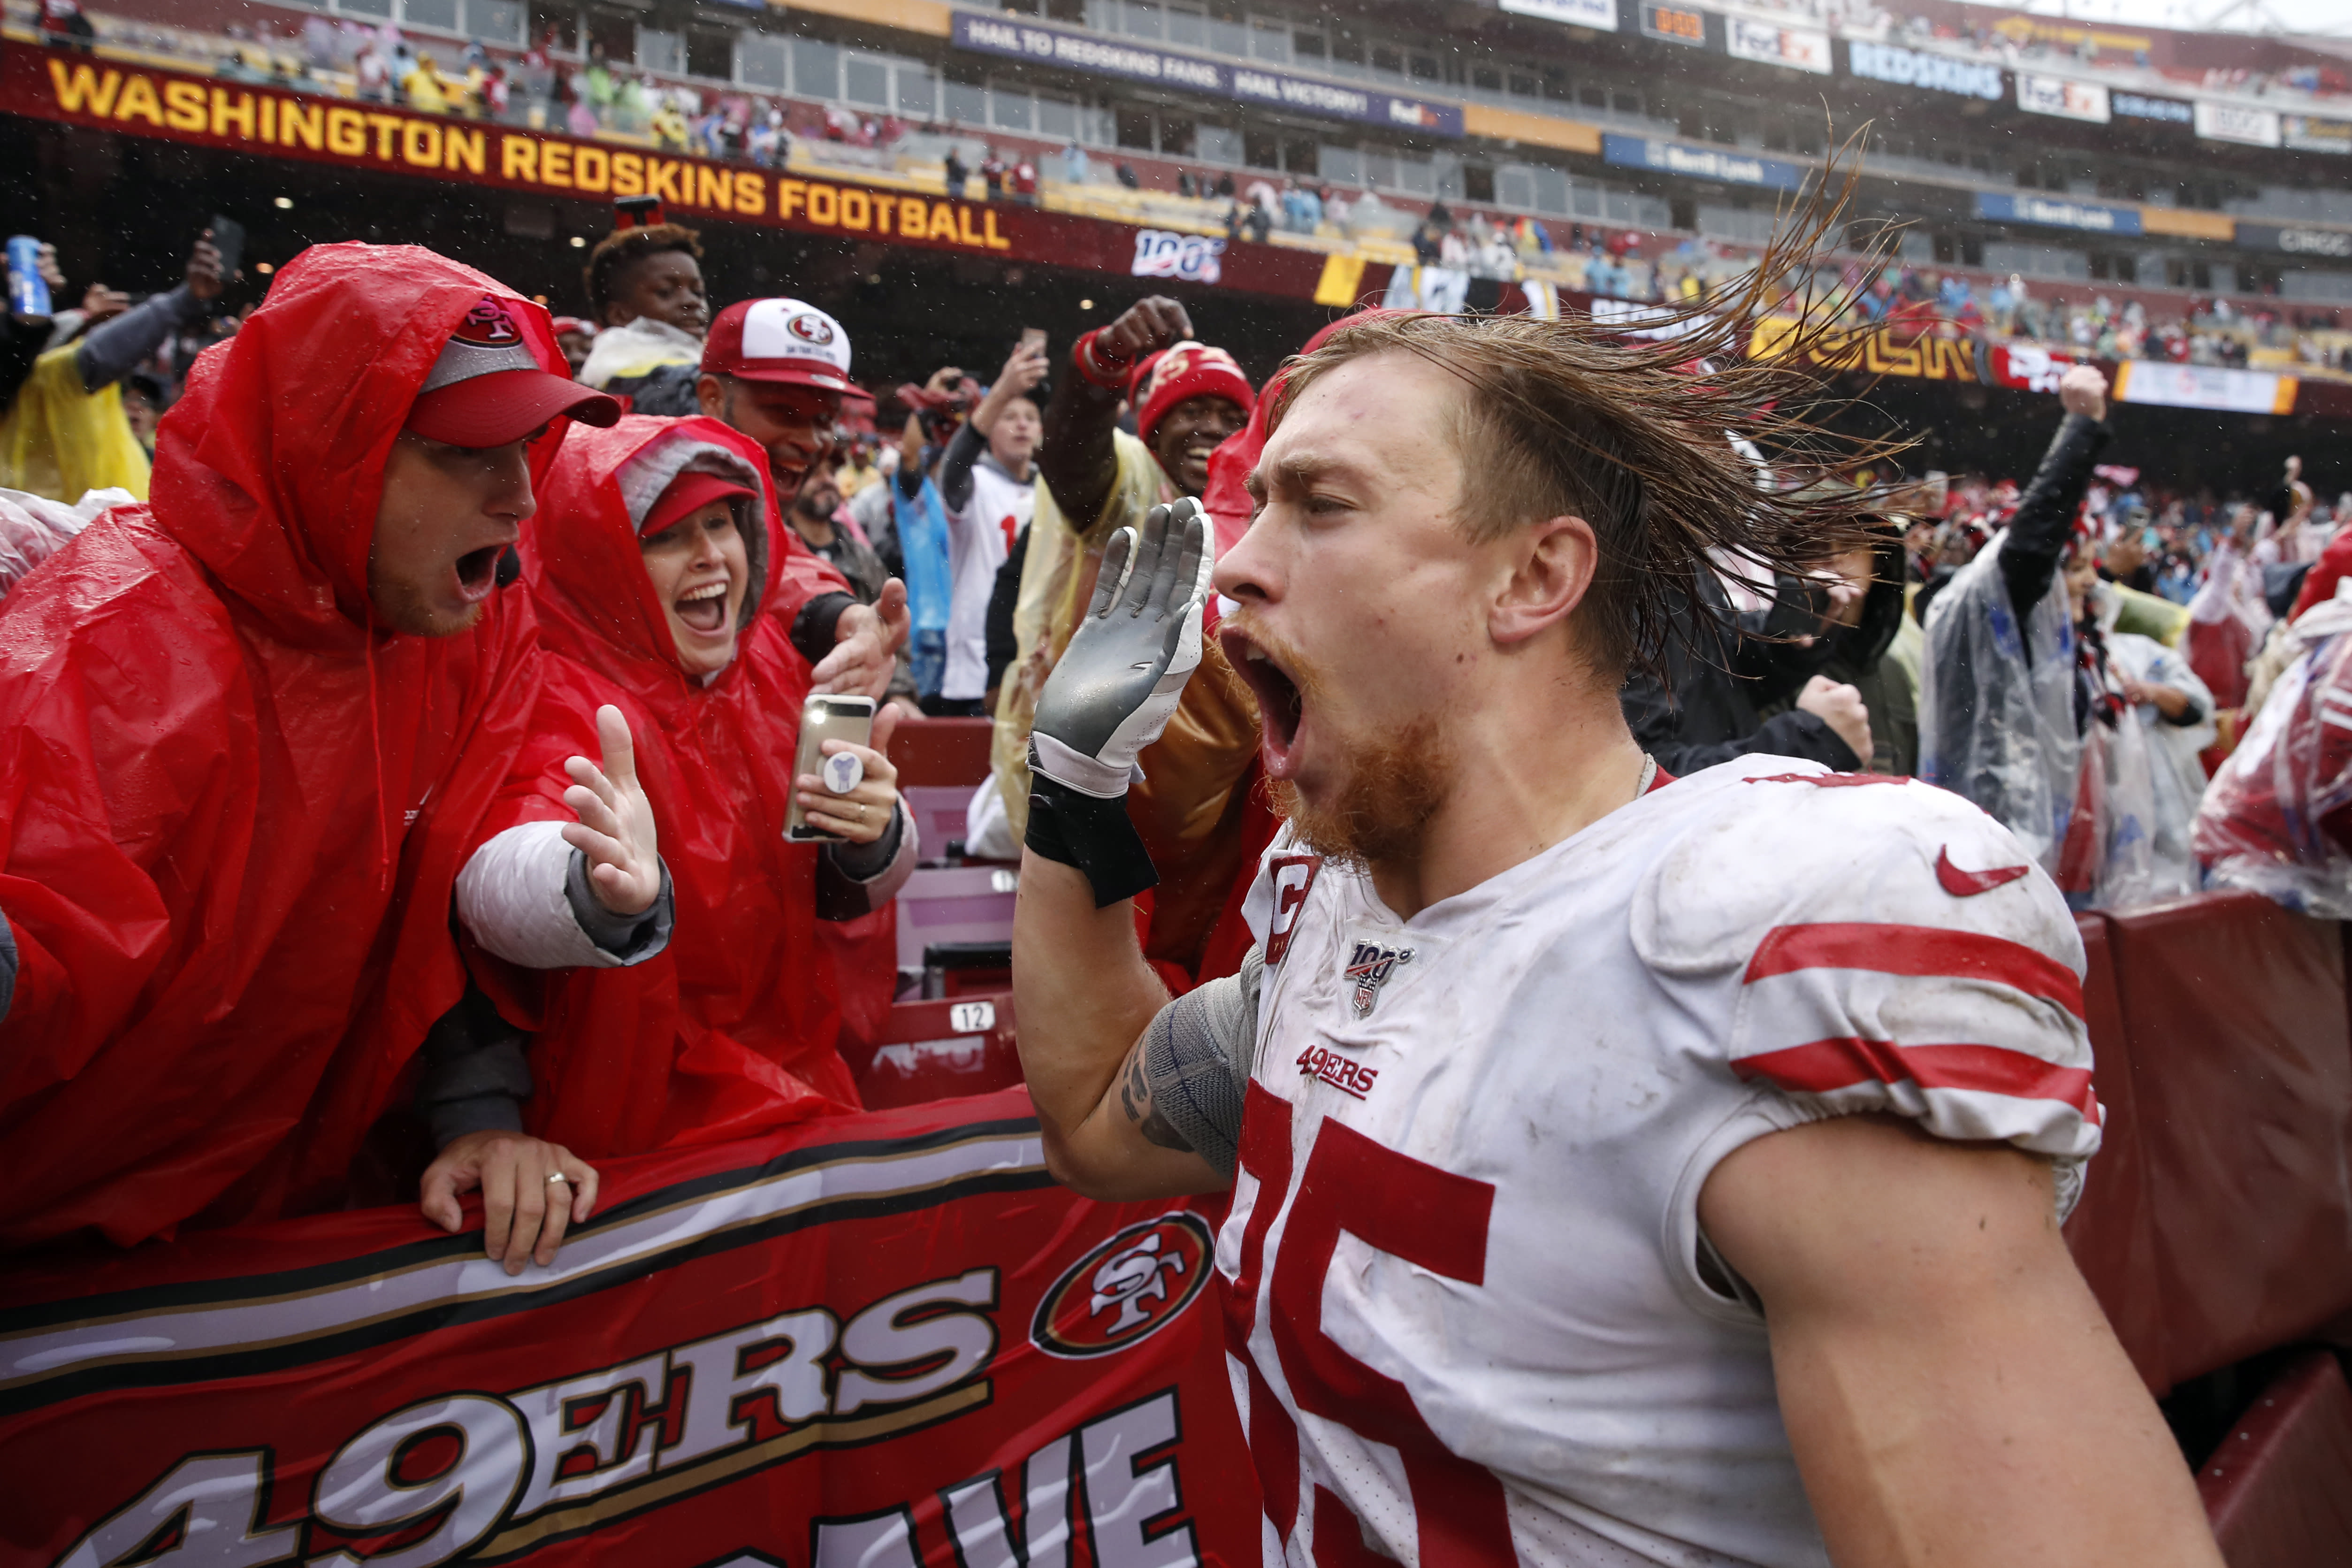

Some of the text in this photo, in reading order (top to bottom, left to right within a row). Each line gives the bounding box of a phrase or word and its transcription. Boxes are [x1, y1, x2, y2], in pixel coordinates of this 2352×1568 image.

[968, 19, 1020, 50] HAIL
[1021, 29, 1053, 55] TO
[1054, 36, 1161, 76] REDSKINS
[1234, 70, 1280, 99] HAIL
[1849, 41, 2003, 100] REDSKINS
[48, 58, 1011, 250] WASHINGTON REDSKINS FOOTBALL
[1273, 864, 1308, 935] C
[962, 1006, 985, 1030] 12
[1296, 1044, 1378, 1093] 49ERS
[1090, 1231, 1185, 1338] SF
[49, 1265, 1000, 1568] 49ERS
